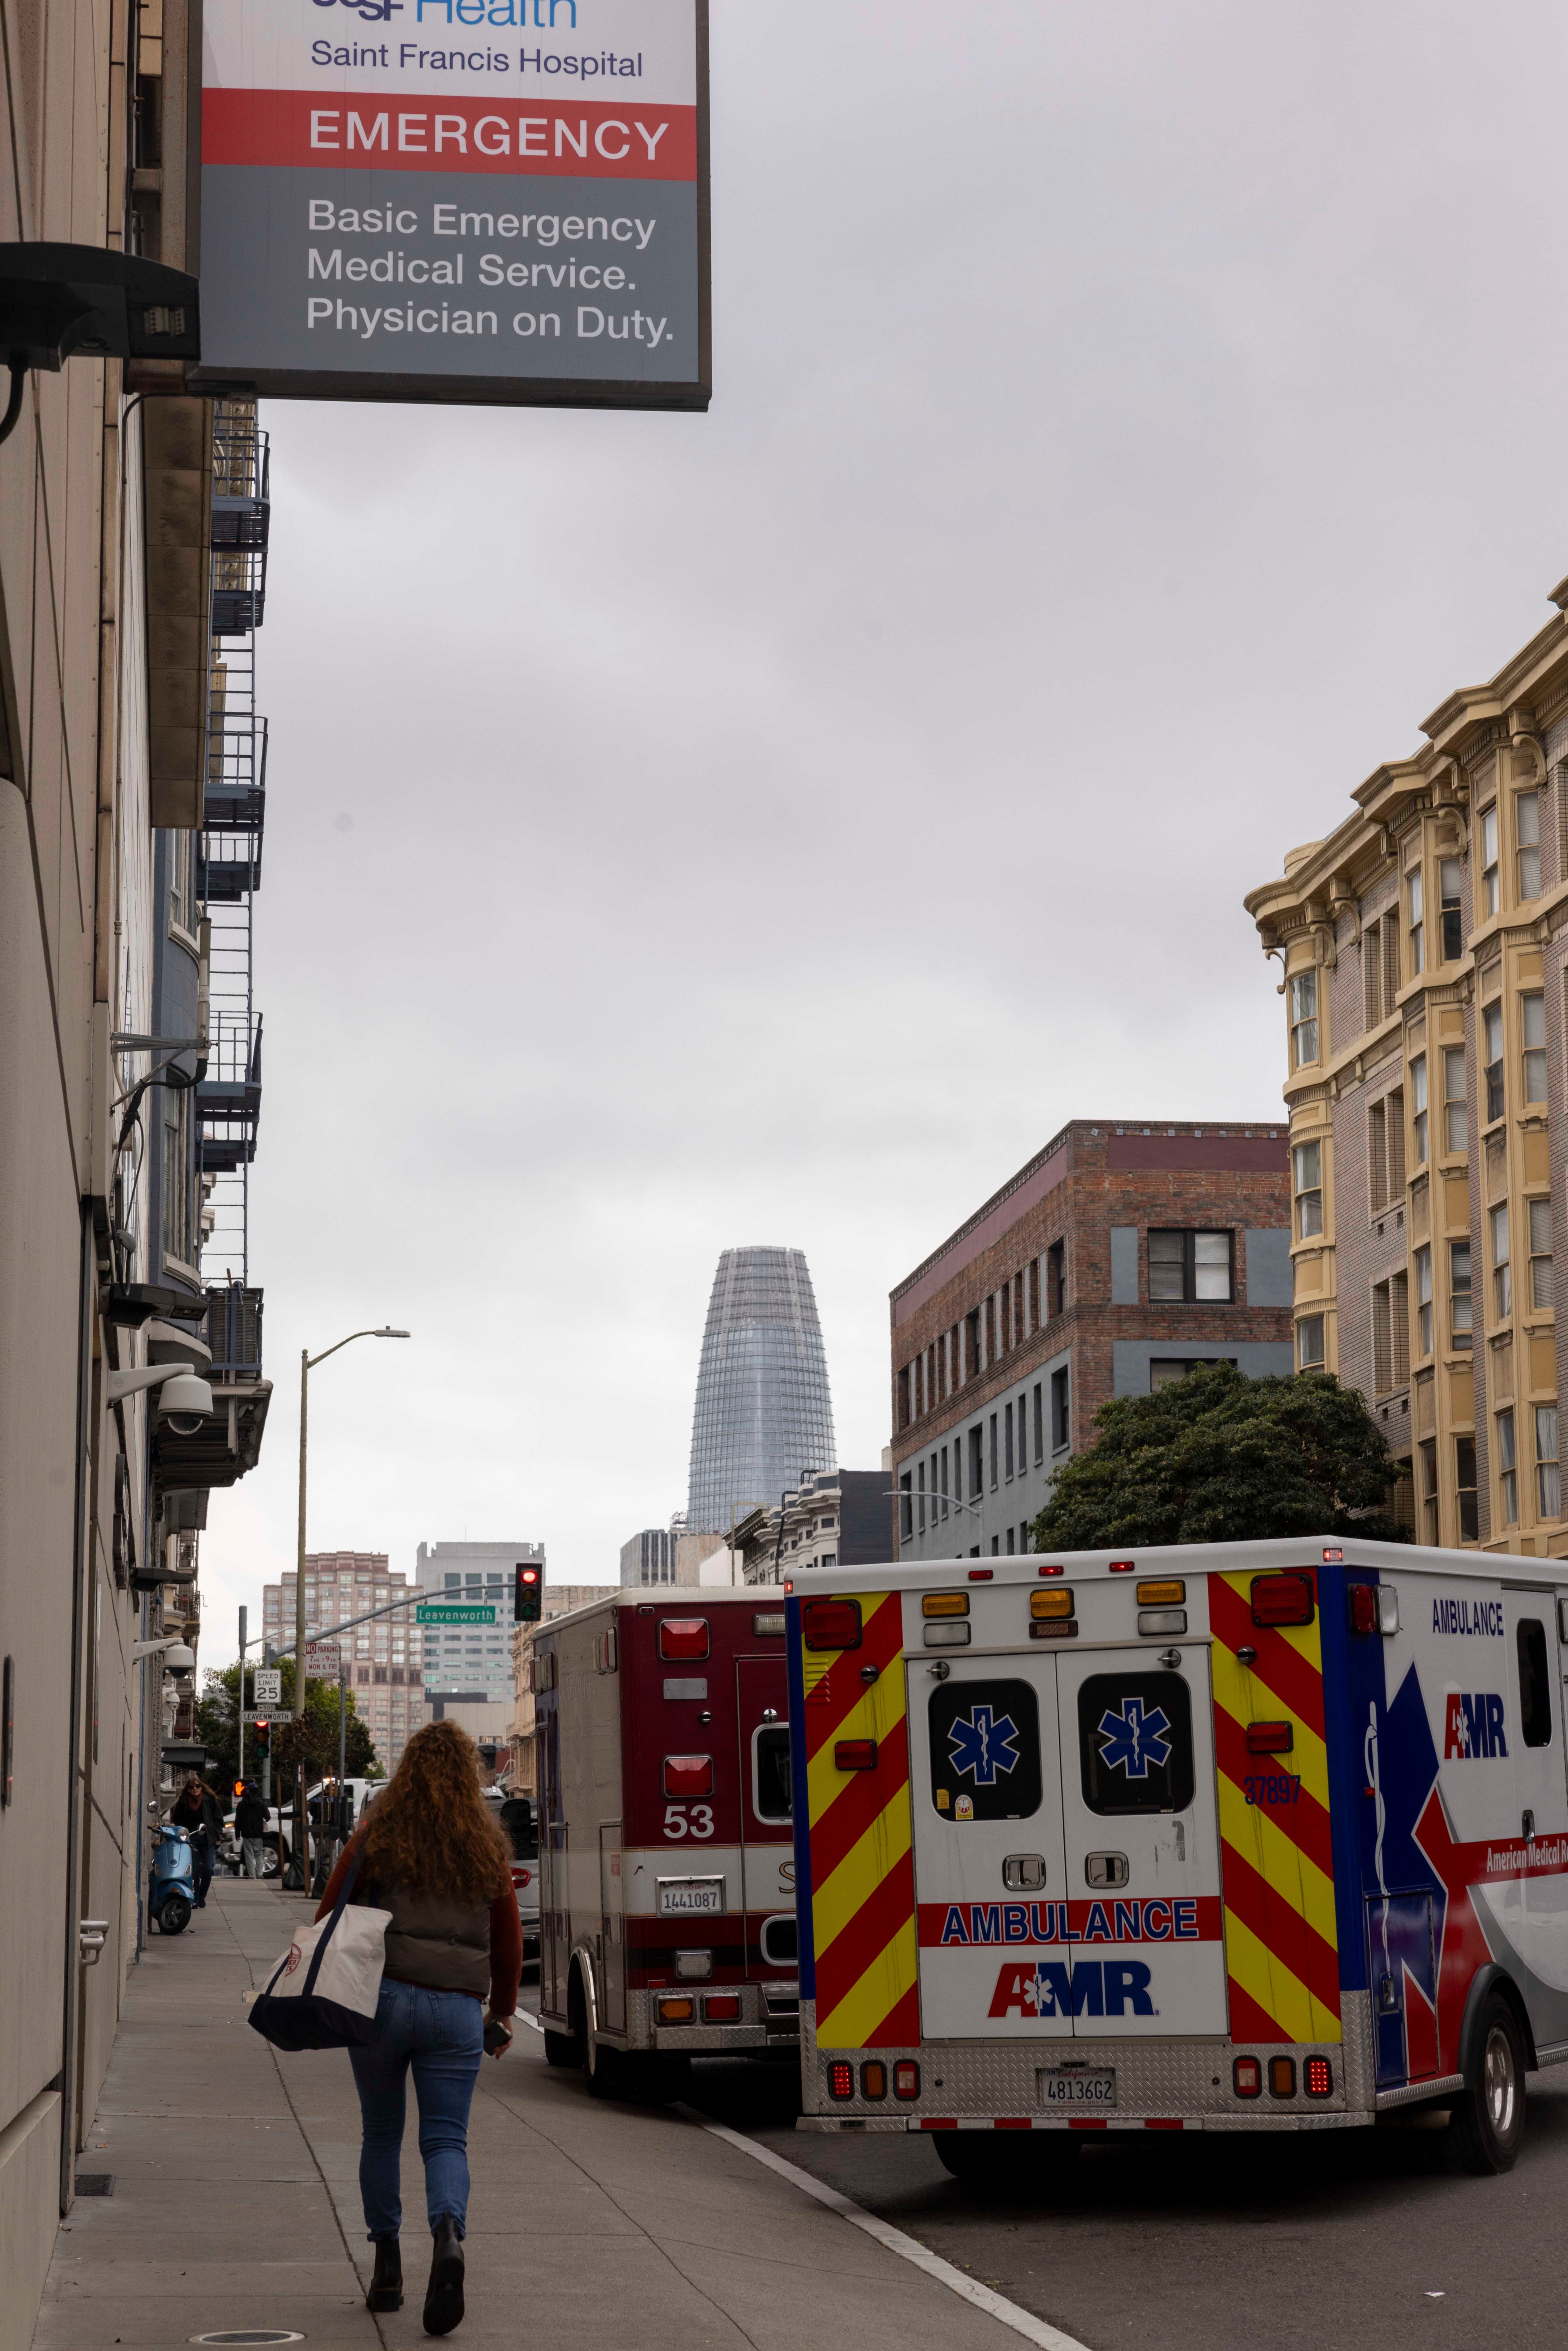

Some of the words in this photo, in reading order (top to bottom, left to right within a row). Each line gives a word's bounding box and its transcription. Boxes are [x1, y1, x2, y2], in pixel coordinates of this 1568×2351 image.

[312, 0, 403, 21] SF
[311, 40, 388, 67] Saint
[400, 44, 510, 71] Francis
[519, 48, 643, 80] Hospital
[310, 109, 669, 160] EMERGENCY
[307, 199, 418, 235] Basic
[433, 203, 657, 250] Emergency
[307, 247, 464, 285] Medical
[478, 254, 636, 290] Service.
[307, 297, 498, 339] Physician
[512, 312, 561, 337] on
[576, 306, 674, 348] Duty.
[419, 1609, 492, 1620] Leavenworth
[1432, 1598, 1504, 1636] AMBULANCE
[306, 1644, 315, 1653] NO
[257, 1687, 278, 1699] 25
[1444, 1694, 1507, 1759] AMR
[1244, 1775, 1301, 1805] 37897
[663, 1805, 714, 1838] 53
[1487, 1844, 1527, 1872] American
[1528, 1839, 1560, 1867] Medical
[1561, 1839, 1568, 1863] R
[664, 1892, 717, 1908] 1441087
[940, 1899, 1199, 1944] AMBULANCE
[987, 1961, 1155, 2018] AMR
[1048, 2080, 1112, 2099] 48136G2
[1058, 2068, 1103, 2080] California
